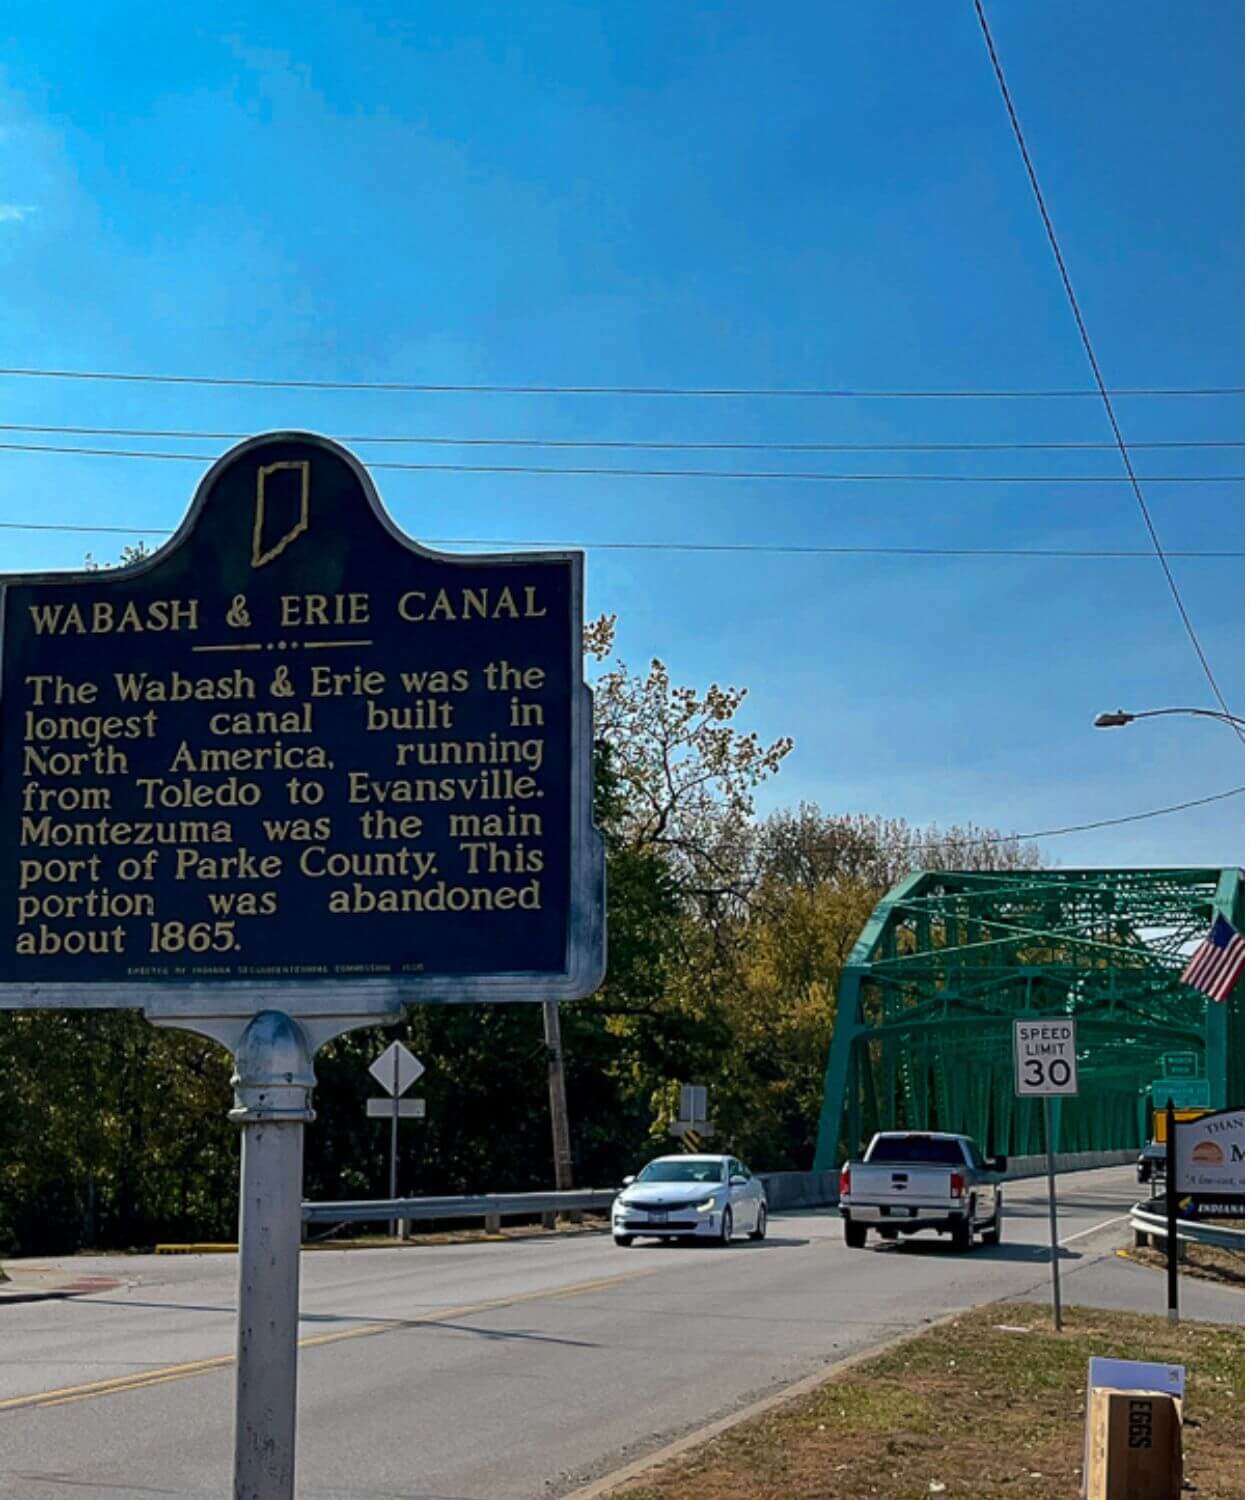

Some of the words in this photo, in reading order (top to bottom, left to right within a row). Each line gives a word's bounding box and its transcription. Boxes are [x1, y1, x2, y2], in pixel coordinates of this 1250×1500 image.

[29, 600, 198, 634] WABASH
[227, 594, 252, 627] &
[281, 594, 370, 626] ERIE
[398, 586, 547, 620] CANAL
[25, 673, 97, 706] The
[115, 668, 255, 702] Wabash
[270, 665, 296, 698] &
[311, 665, 386, 697] Erie
[401, 669, 469, 693] was
[483, 660, 546, 691] the
[23, 709, 158, 745] longest
[209, 703, 313, 735] canal
[367, 699, 455, 732] built
[510, 694, 544, 726] in
[22, 745, 129, 777] North
[169, 740, 335, 774] America,
[396, 738, 544, 768] running
[22, 782, 111, 811] from
[136, 776, 262, 809] Toledo
[286, 777, 325, 805] to
[347, 768, 545, 807] Evansville.
[20, 815, 233, 848] Montezuma
[263, 819, 332, 842] was
[360, 810, 424, 840] the
[449, 806, 543, 838] main
[19, 855, 102, 889] port
[117, 849, 161, 880] of
[175, 846, 283, 880] Parke
[299, 845, 438, 881] County.
[459, 841, 544, 874] This
[17, 887, 156, 925] portion
[207, 895, 278, 915] was
[328, 878, 542, 914] abandoned
[15, 922, 127, 955] about
[149, 920, 242, 953] 1865.
[1020, 1027, 1072, 1041] SPEED
[1026, 1043, 1065, 1056] LIMIT
[1024, 1059, 1071, 1087] 30
[1129, 1400, 1153, 1448] EGGS
